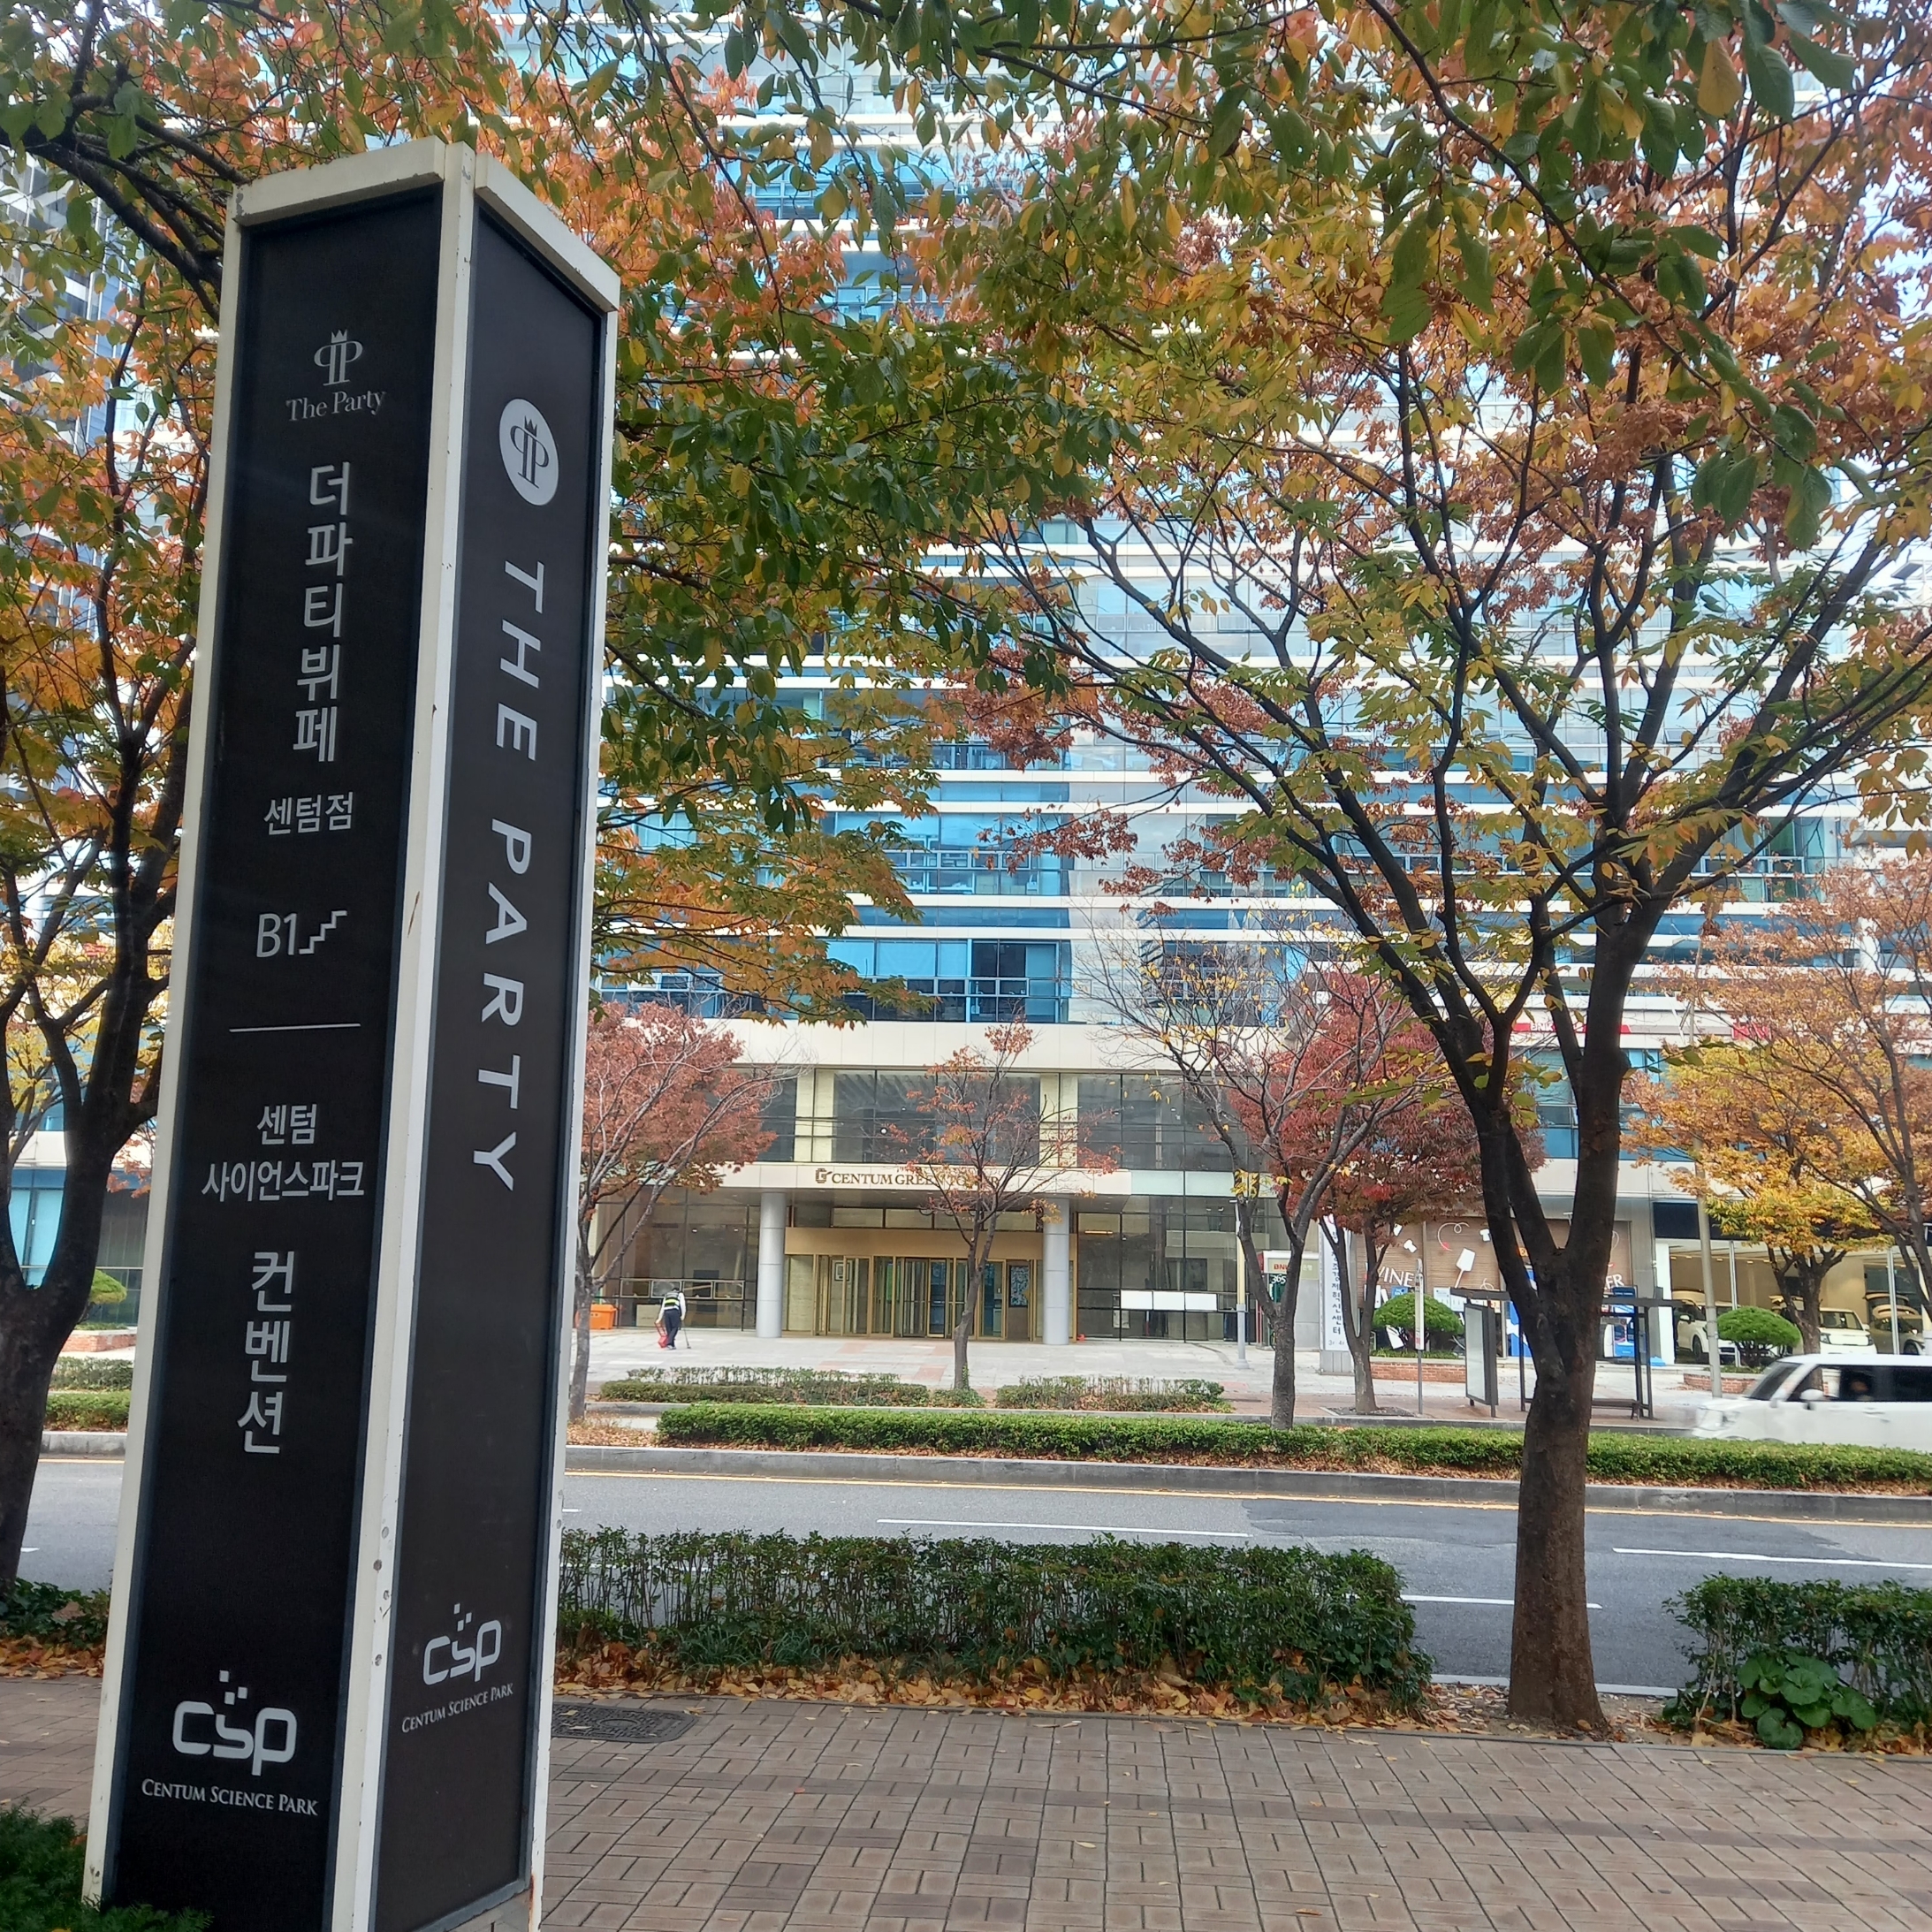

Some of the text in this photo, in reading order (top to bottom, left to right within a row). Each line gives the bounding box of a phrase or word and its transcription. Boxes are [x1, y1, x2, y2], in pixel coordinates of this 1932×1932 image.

[285, 390, 387, 422] The Party
[293, 461, 353, 762] 더파티뷔페
[263, 791, 354, 836] 센텀점
[473, 559, 545, 1191] THE PARTY
[256, 912, 298, 958] B1
[257, 1103, 317, 1145] 센텀
[202, 1159, 364, 1203] 사이언스파크
[832, 1173, 893, 1185] CENTUM
[1269, 1274, 1287, 1284] 365
[238, 1250, 294, 1455] 컨벤션
[141, 1777, 319, 1816] CENTUM SCIENCE PARK
